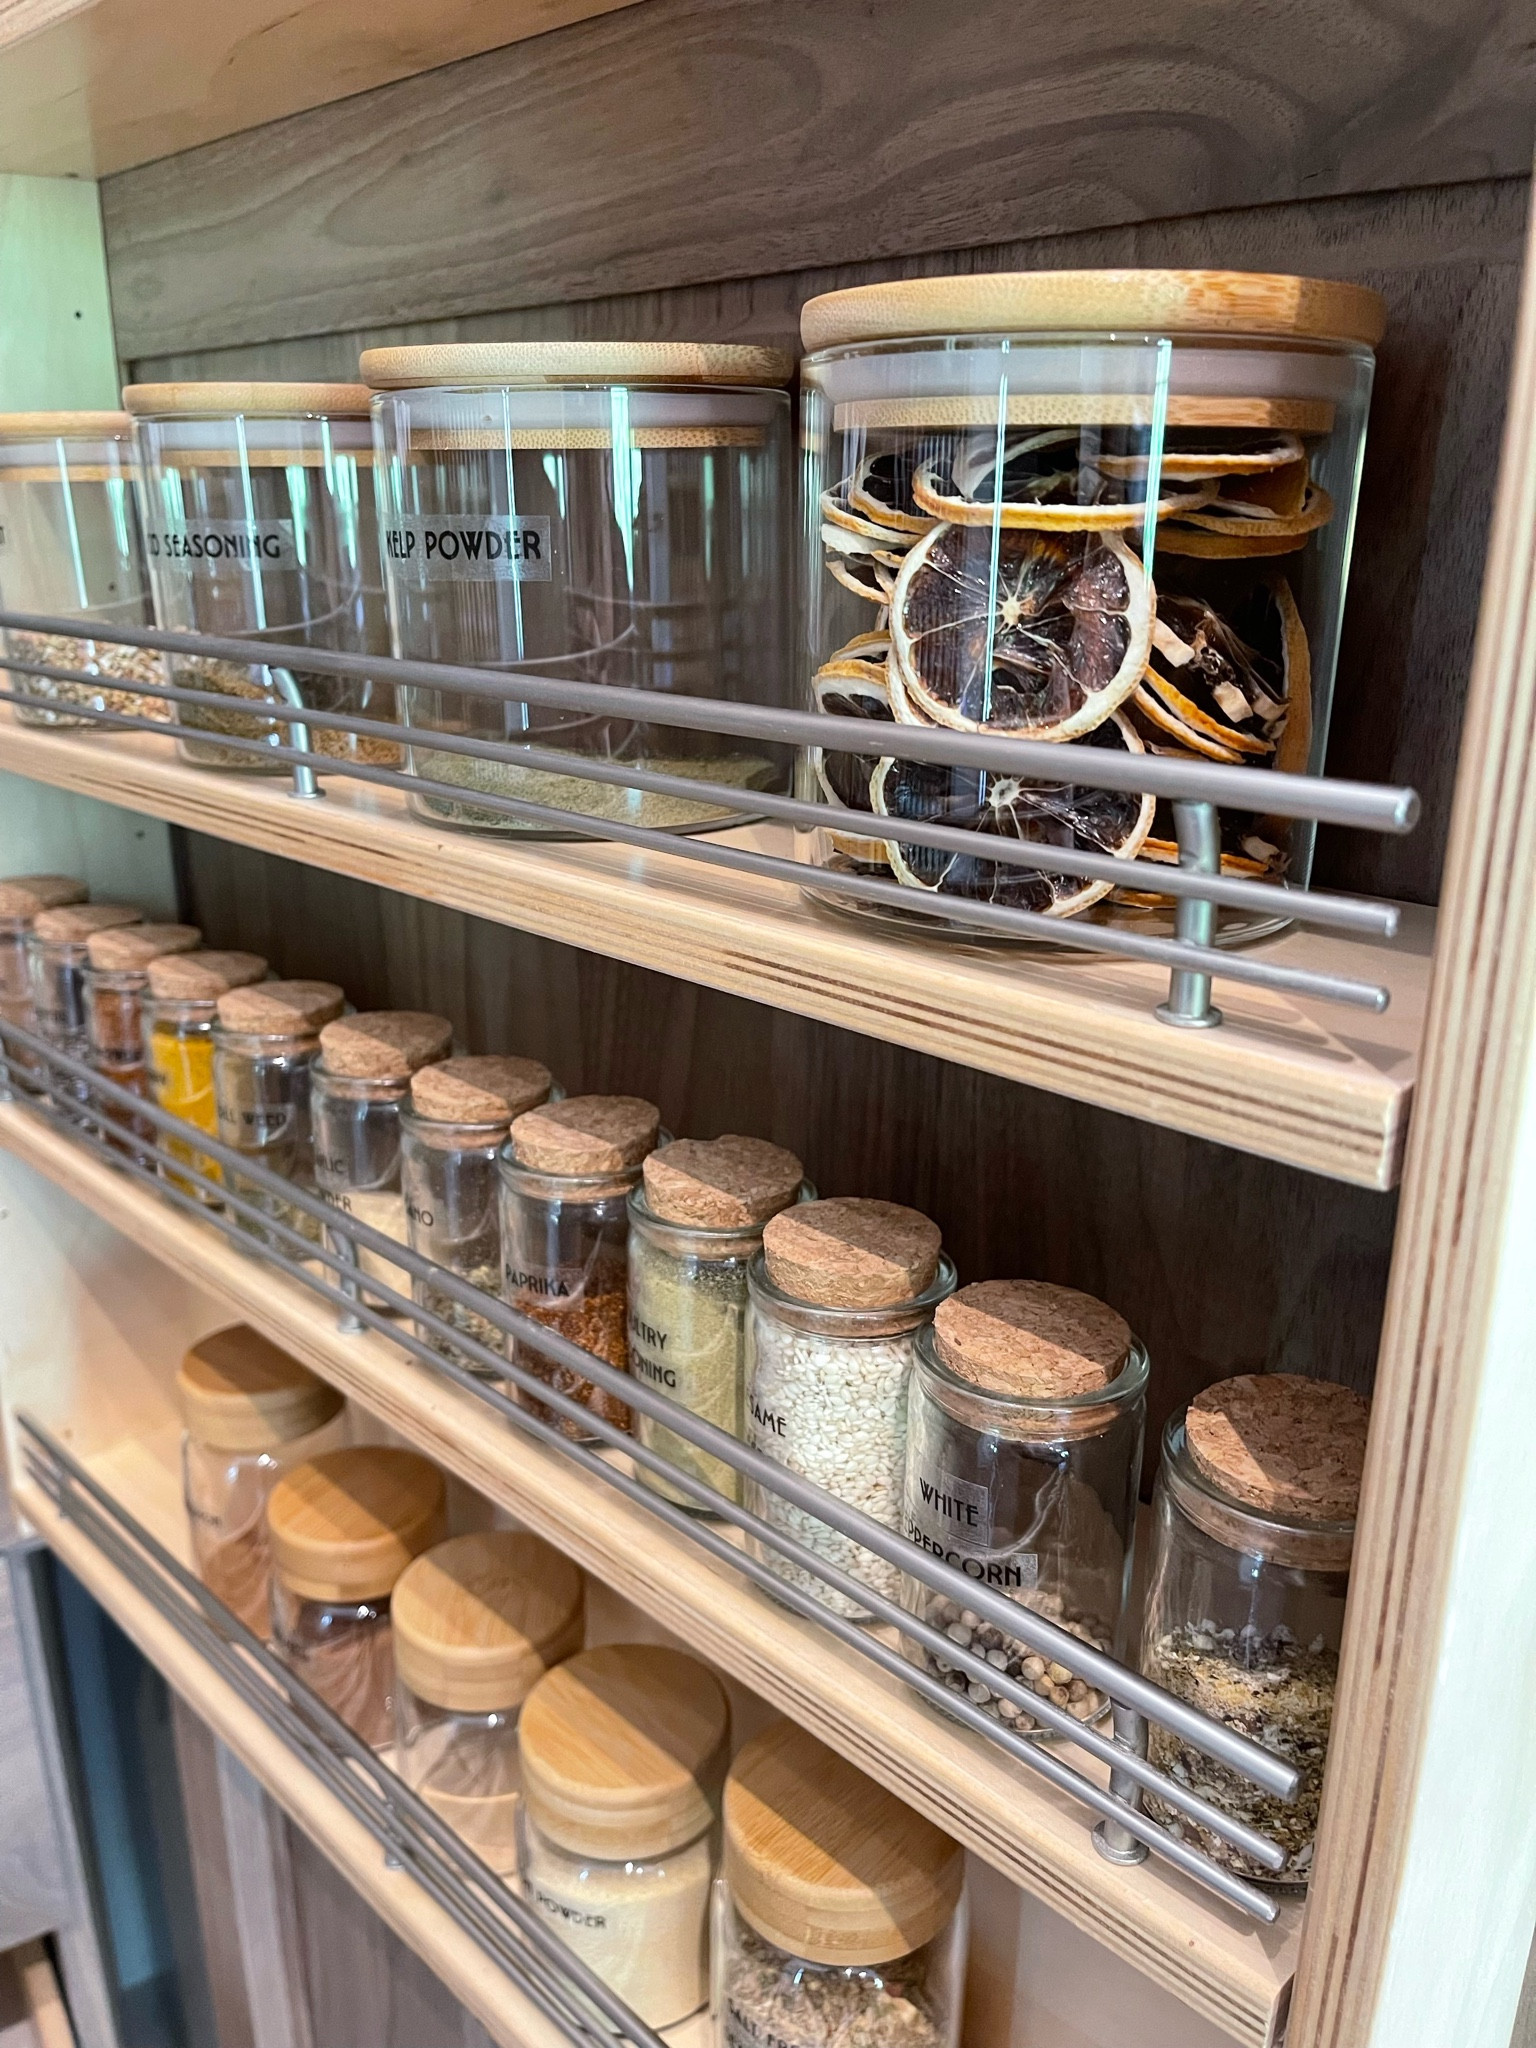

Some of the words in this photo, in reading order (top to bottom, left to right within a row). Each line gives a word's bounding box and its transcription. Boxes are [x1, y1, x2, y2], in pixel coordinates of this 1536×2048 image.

[164, 533, 280, 558] SEASONING
[386, 530, 416, 559] KELP
[425, 530, 541, 560] POWDER
[506, 1263, 570, 1297] PAPRIKA
[920, 1477, 979, 1527] WHITE
